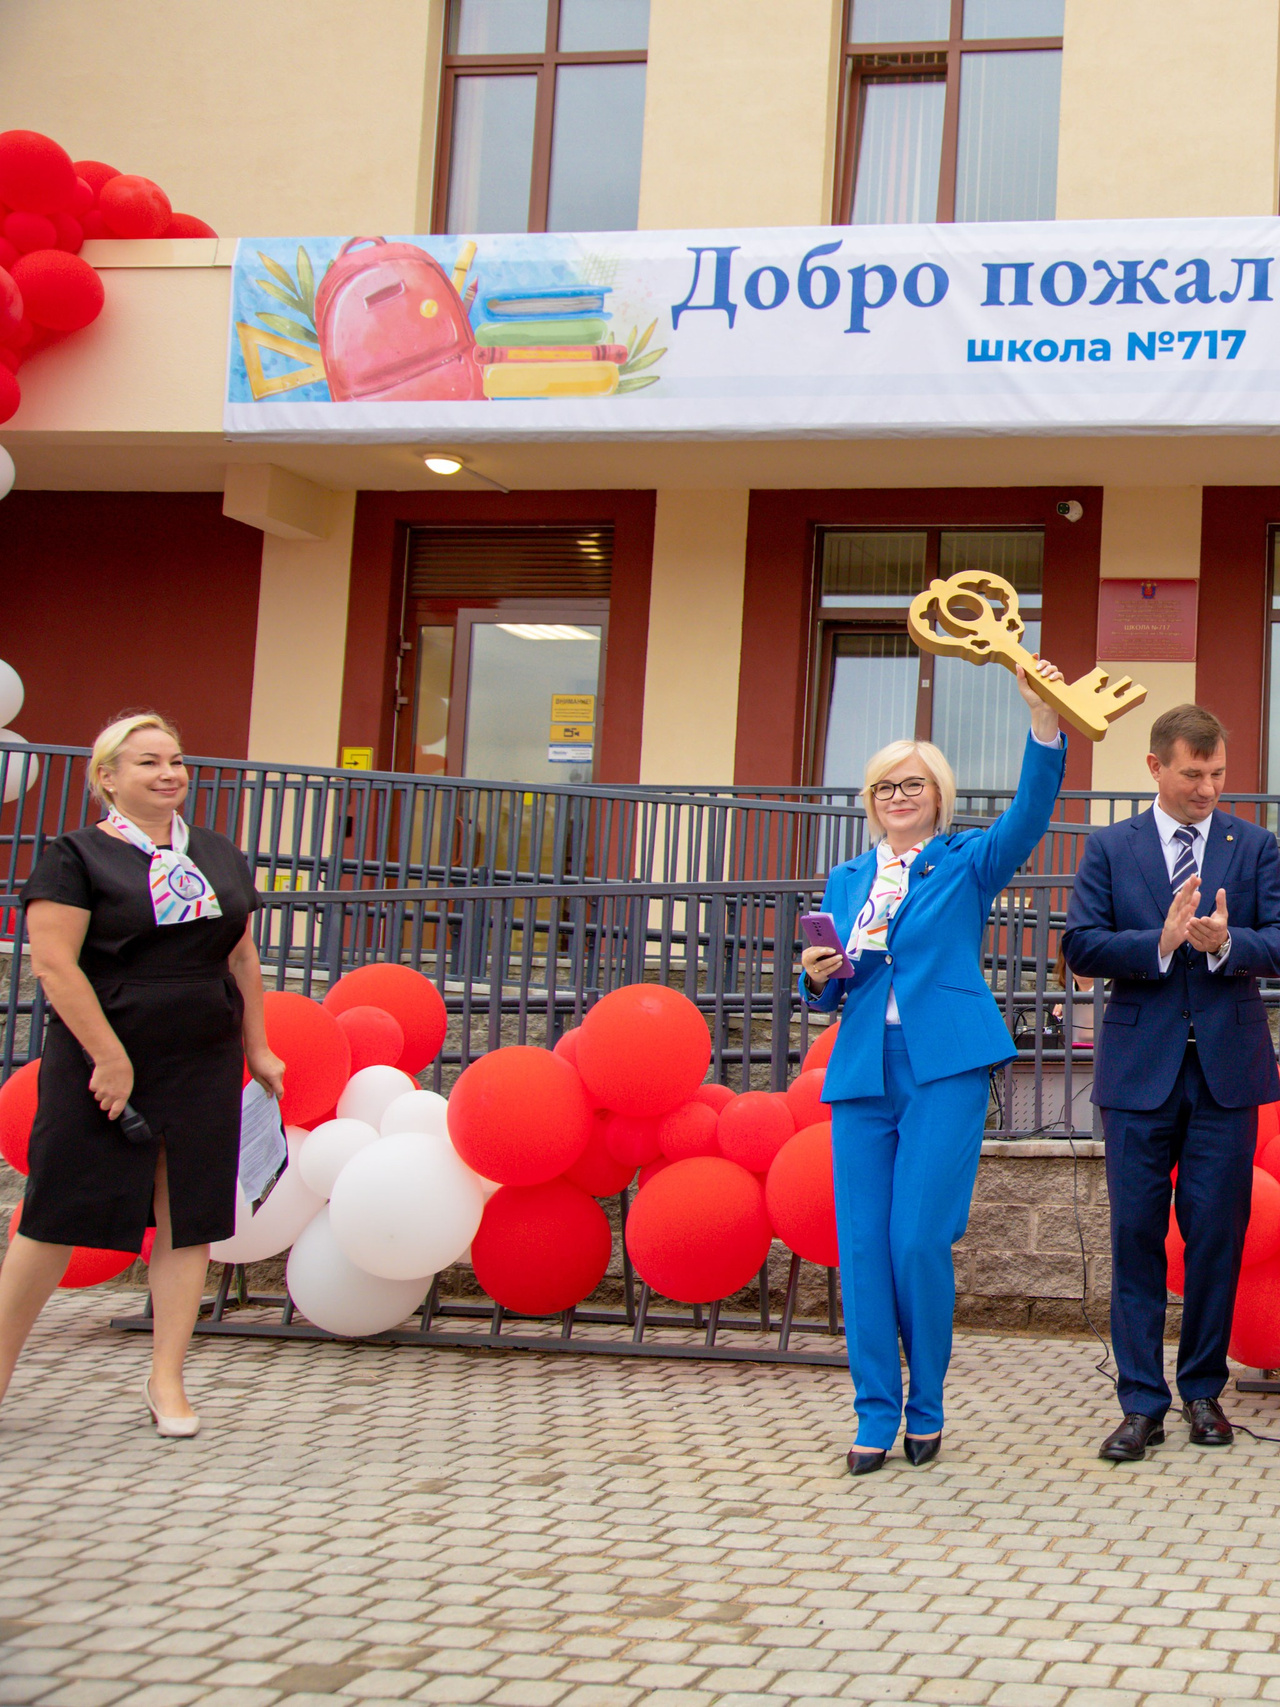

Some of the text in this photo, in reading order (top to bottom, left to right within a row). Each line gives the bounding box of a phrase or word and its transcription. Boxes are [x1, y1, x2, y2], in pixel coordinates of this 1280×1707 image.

[670, 239, 950, 334] Добро
[966, 329, 1247, 363] школа №717
